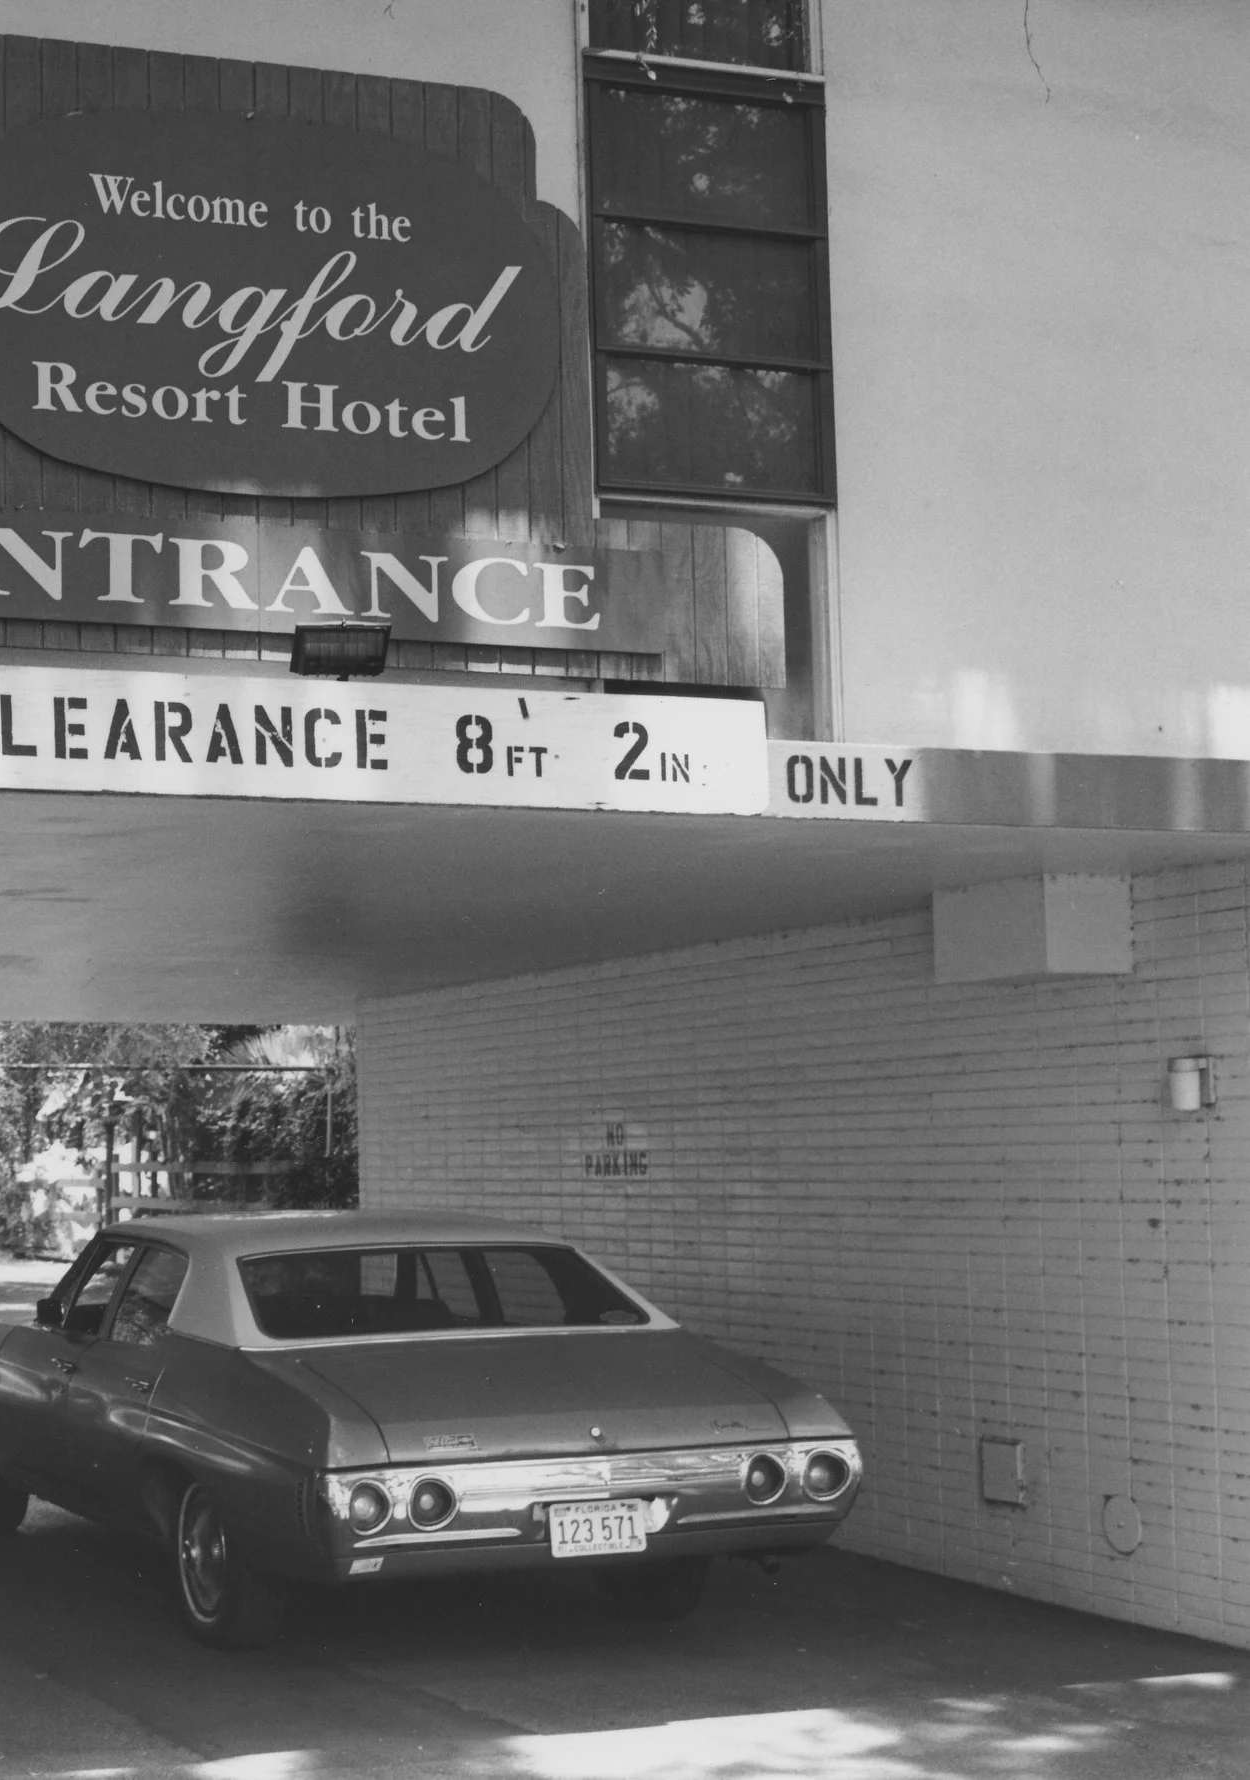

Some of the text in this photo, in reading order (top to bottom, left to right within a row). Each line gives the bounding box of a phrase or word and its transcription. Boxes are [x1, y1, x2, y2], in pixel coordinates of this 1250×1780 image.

[89, 172, 412, 243] Welcome to the
[31, 360, 472, 444] Resort Hotel
[786, 754, 914, 807] ONLY
[606, 1121, 625, 1147] NO
[584, 1150, 649, 1177] PARKING
[574, 1503, 617, 1514] FLORIDA
[558, 1515, 639, 1545] 123 571
